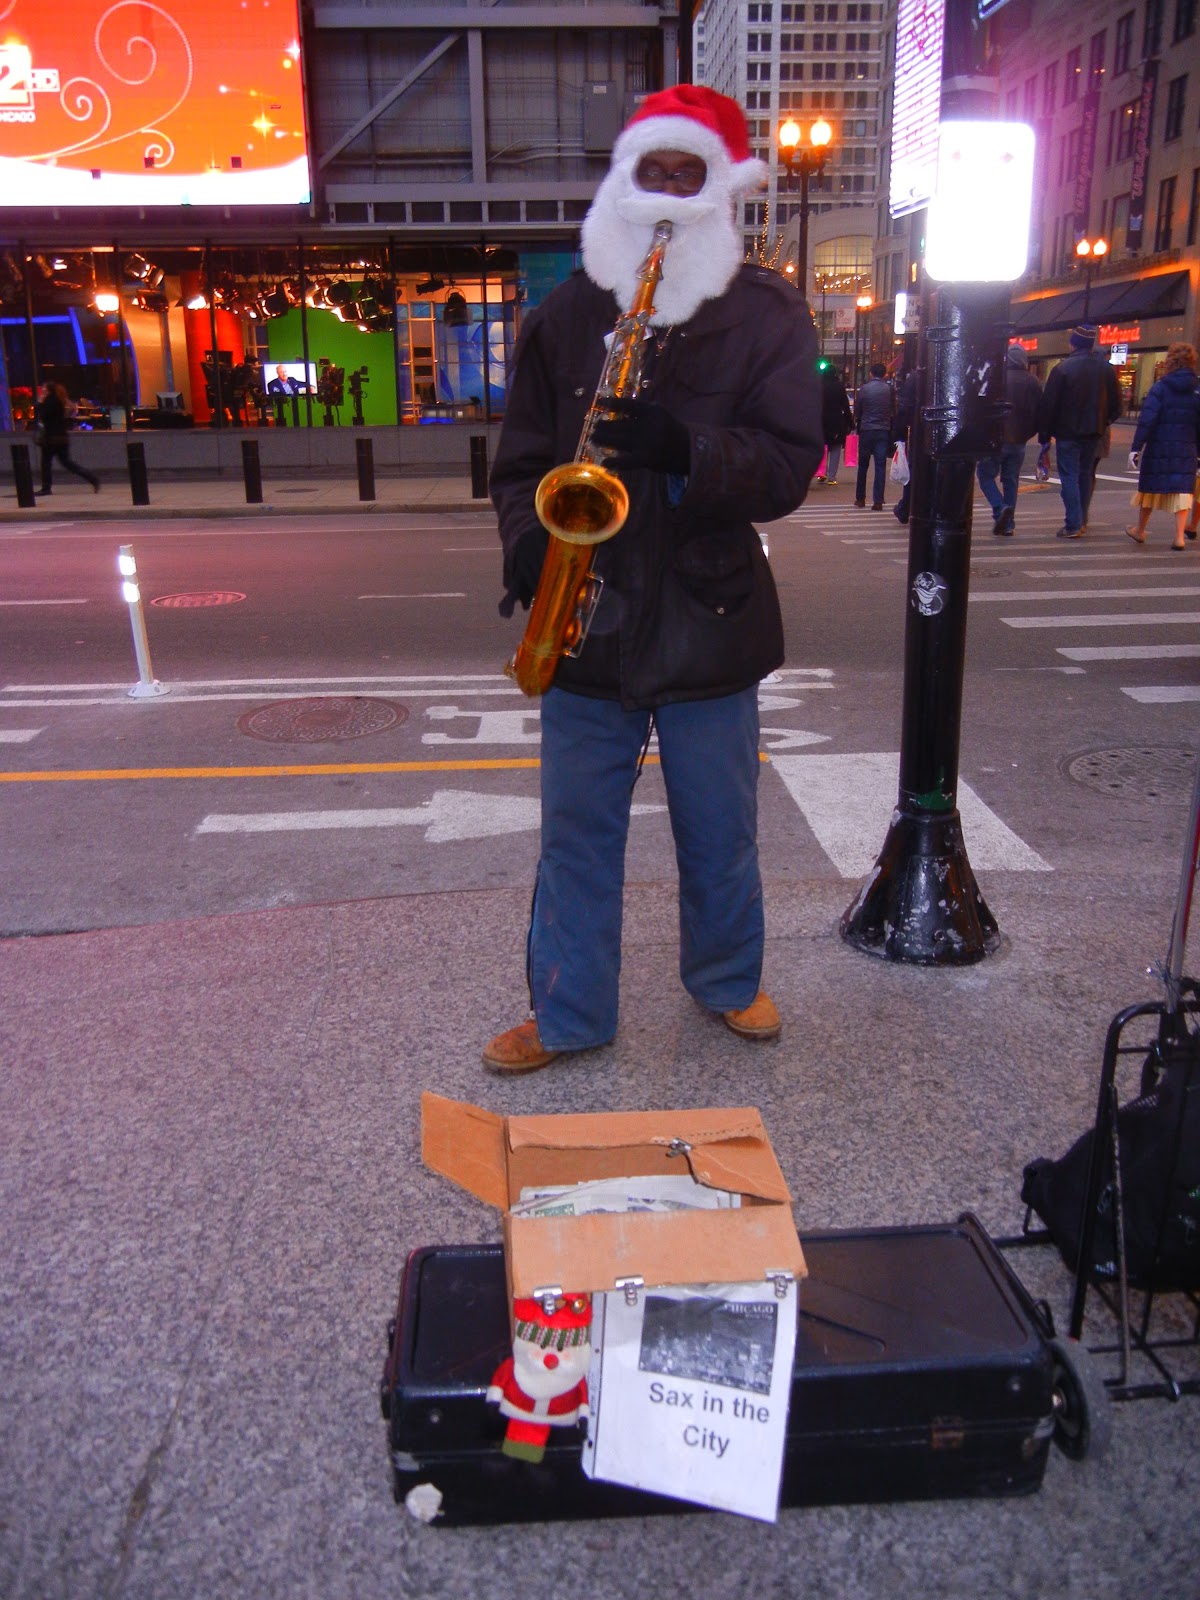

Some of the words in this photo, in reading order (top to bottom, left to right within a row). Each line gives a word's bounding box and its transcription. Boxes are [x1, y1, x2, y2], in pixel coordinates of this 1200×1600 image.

[30, 72, 58, 89] HD
[0, 112, 36, 122] HICAGO
[724, 1303, 774, 1314] CHICAGO
[649, 1382, 694, 1409] Sax
[703, 1390, 723, 1414] in
[733, 1398, 769, 1423] the
[683, 1425, 730, 1458] City
